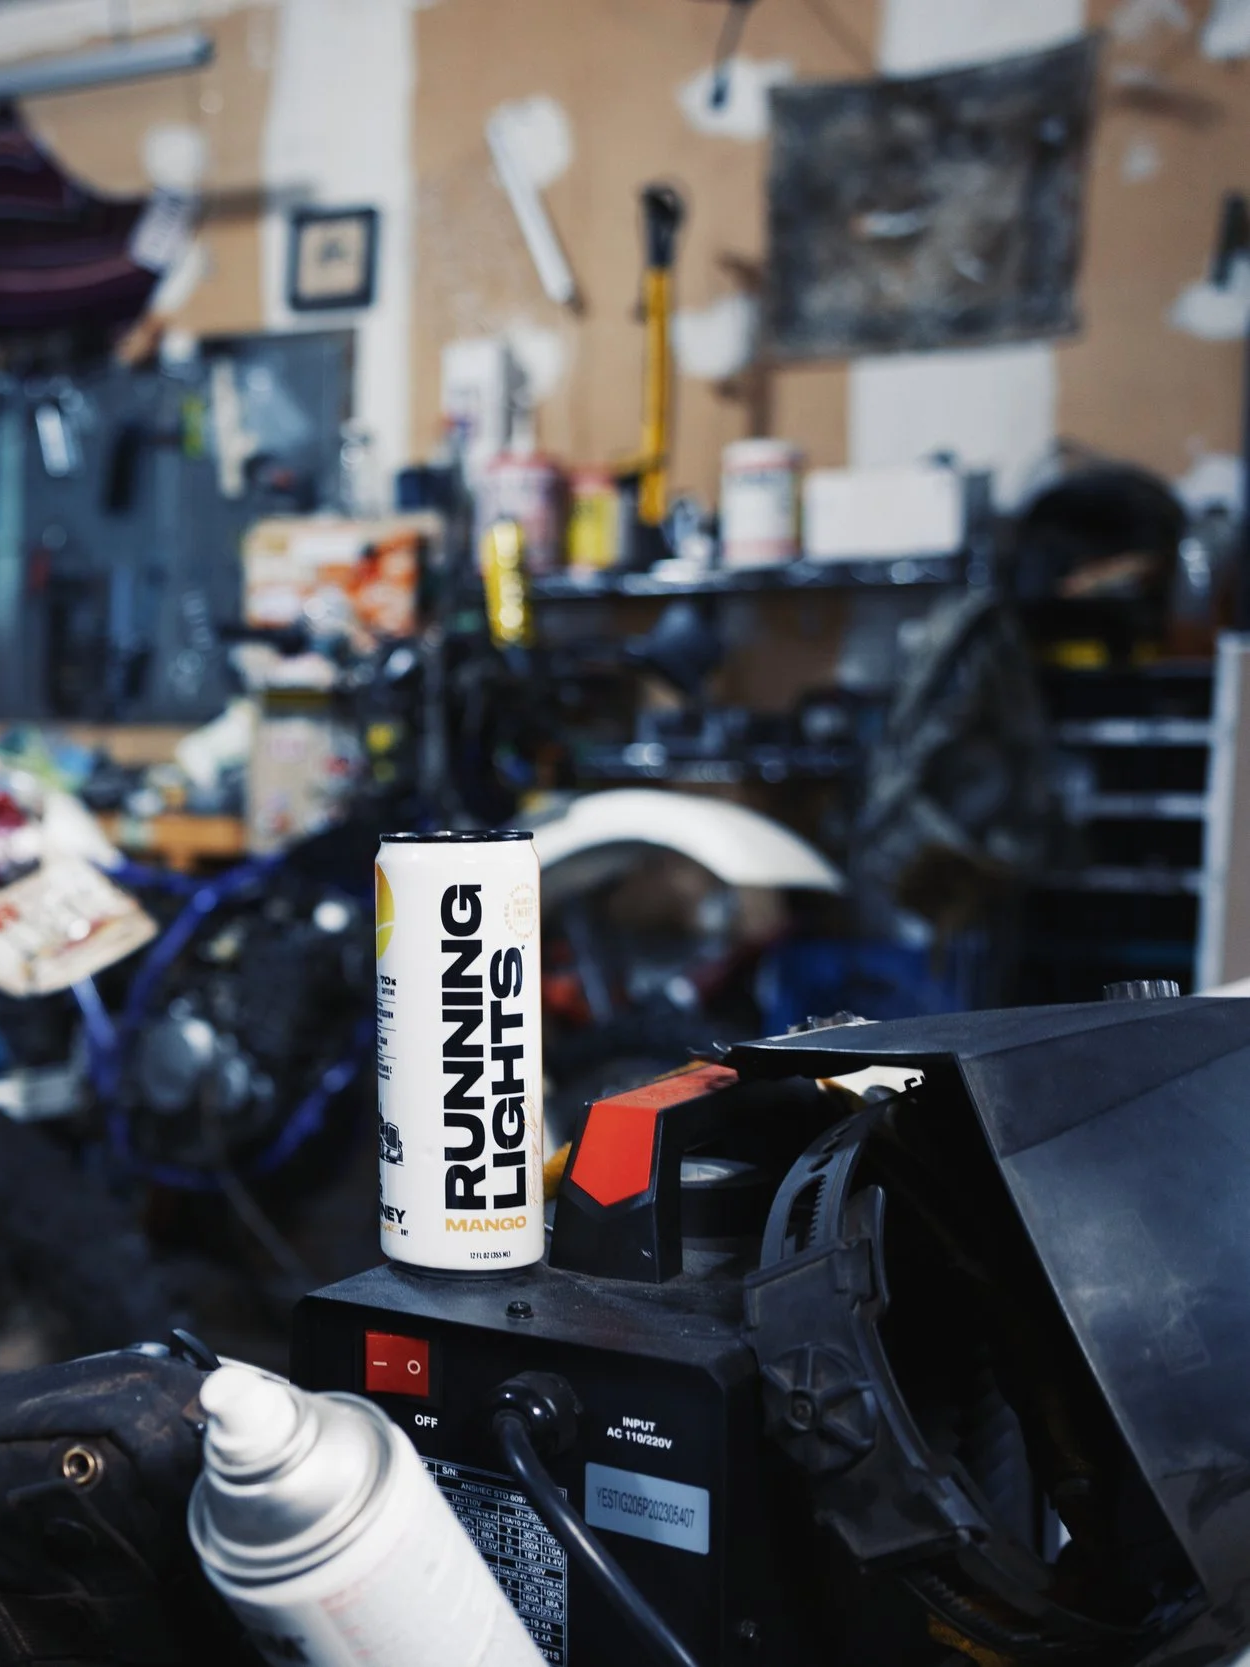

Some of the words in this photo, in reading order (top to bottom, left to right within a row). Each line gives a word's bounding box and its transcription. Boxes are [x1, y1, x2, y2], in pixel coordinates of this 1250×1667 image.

[440, 884, 486, 1210] RUNNING
[490, 946, 527, 1210] LIGHTS
[445, 1215, 527, 1232] MANGO
[415, 1414, 438, 1428] OFF
[623, 1416, 656, 1432] INPUT
[607, 1427, 622, 1439] AC
[626, 1430, 672, 1449] 110/220V
[442, 1465, 458, 1477] S/N:
[479, 1520, 497, 1531] 100%
[523, 1531, 539, 1541] 30%
[522, 1541, 539, 1552] 200A
[543, 1555, 563, 1567] 14.4V
[523, 1583, 539, 1594] 30%
[543, 1588, 562, 1600] 100%
